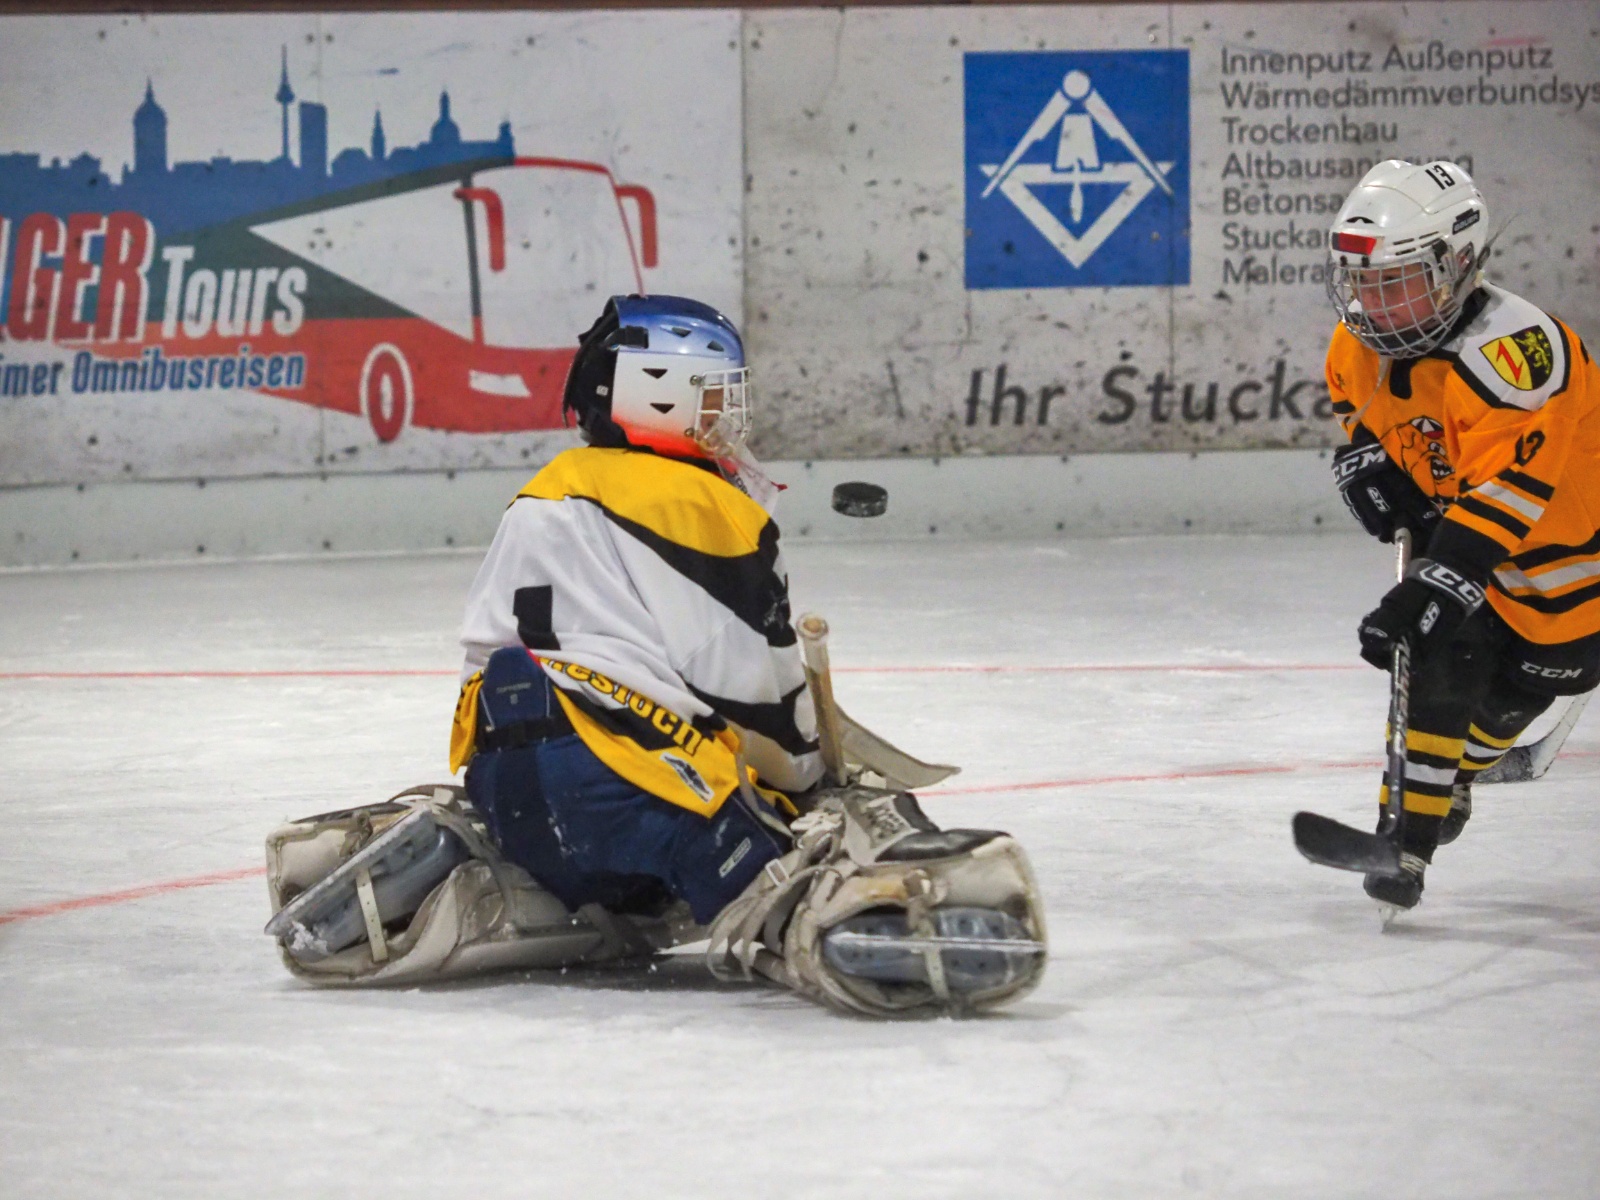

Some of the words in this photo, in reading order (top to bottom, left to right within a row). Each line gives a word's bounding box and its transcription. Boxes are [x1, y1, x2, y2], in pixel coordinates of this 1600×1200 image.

[1221, 47, 1373, 79] Innenputz
[1382, 41, 1554, 79] Außenputz
[1221, 114, 1398, 145] Trockenbau
[1425, 164, 1456, 190] 13
[0, 210, 155, 343] GER
[161, 245, 308, 339] Tours
[0, 353, 64, 396] mer
[71, 344, 305, 393] Omnibusreisen
[965, 363, 1066, 426] Ihr
[1432, 562, 1485, 607] CC
[1521, 659, 1583, 680] CCM
